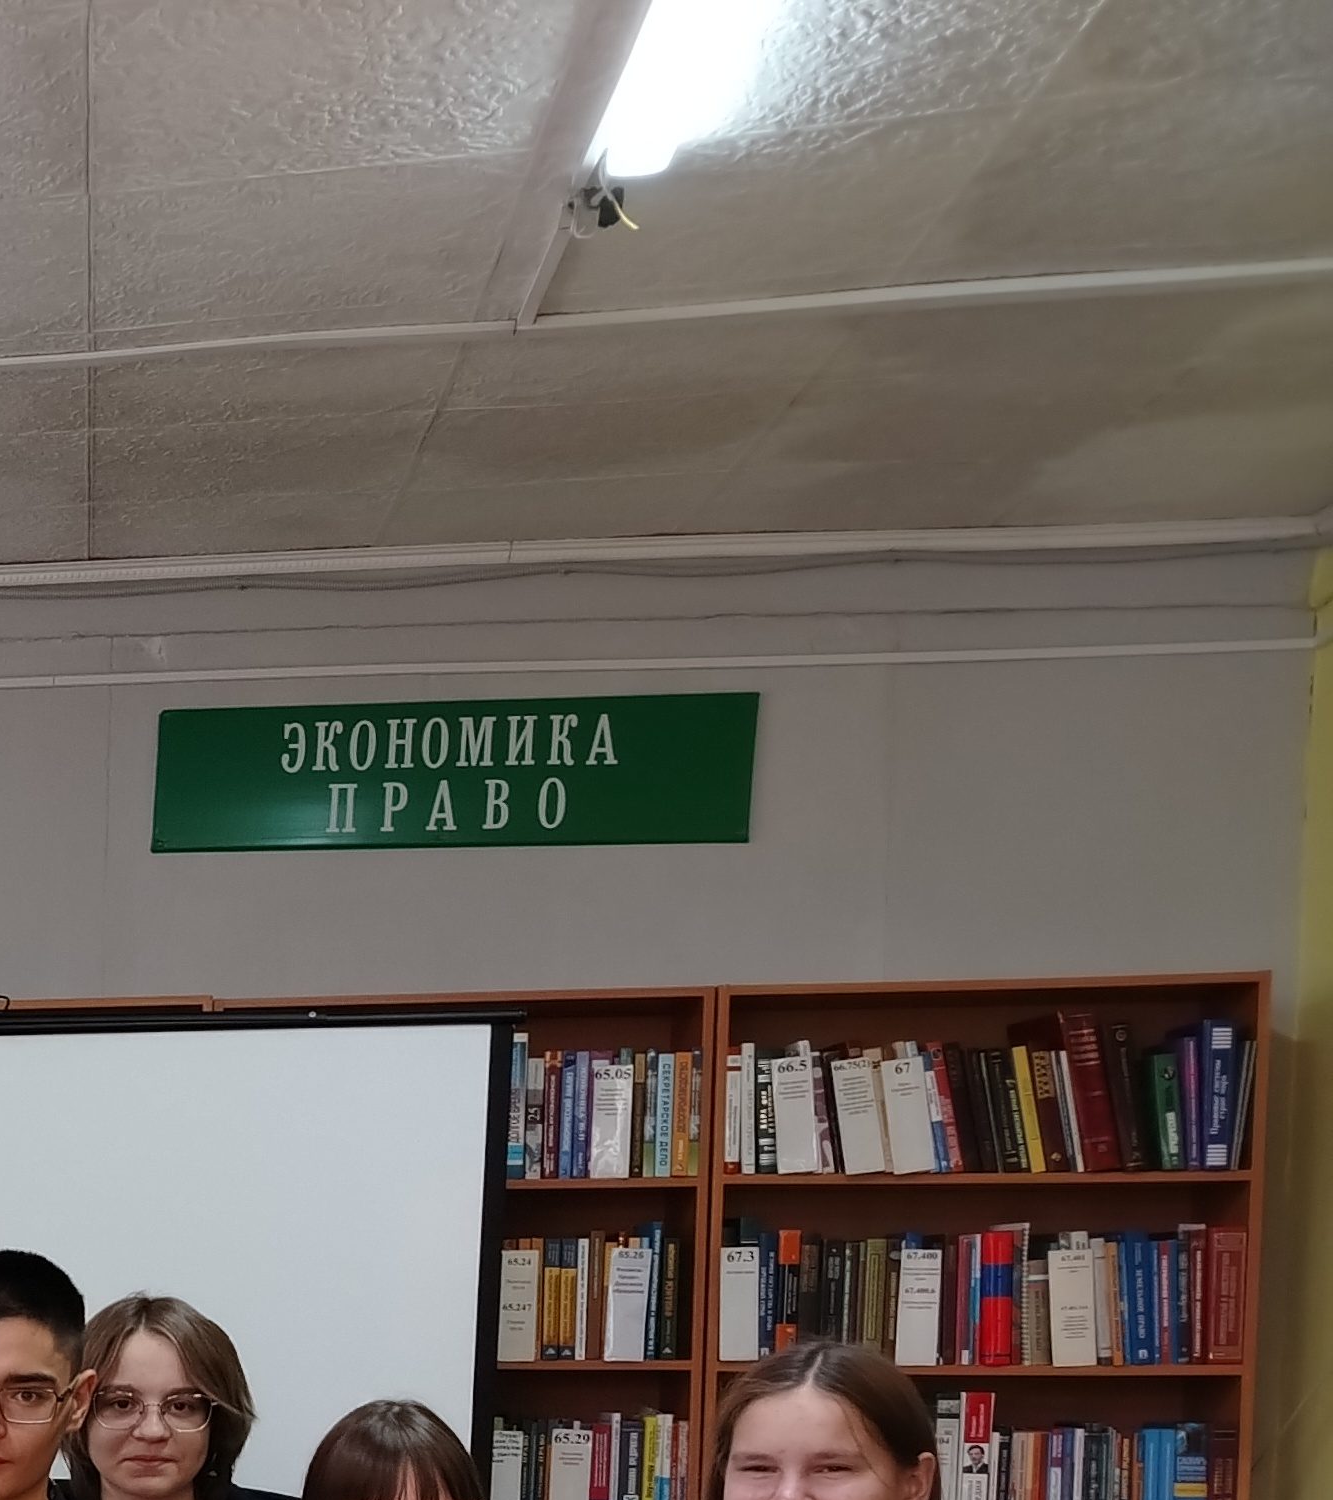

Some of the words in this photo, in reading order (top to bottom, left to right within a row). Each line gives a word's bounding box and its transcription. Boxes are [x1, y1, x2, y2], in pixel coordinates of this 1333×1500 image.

[279, 713, 618, 773] ЭКОНОМИКА
[325, 777, 567, 833] ПРАВО
[777, 1060, 808, 1073] 66.5
[895, 1062, 911, 1075] 67
[595, 1068, 632, 1080] 65.05
[660, 1063, 671, 1137] СЕКРЕТАРСКОЕ
[659, 1141, 669, 1167] ДЕЛО
[507, 1258, 531, 1267] 65.24
[727, 1251, 754, 1262] 67.3
[502, 1303, 532, 1312] 65.247
[554, 1434, 591, 1445] 65.29
